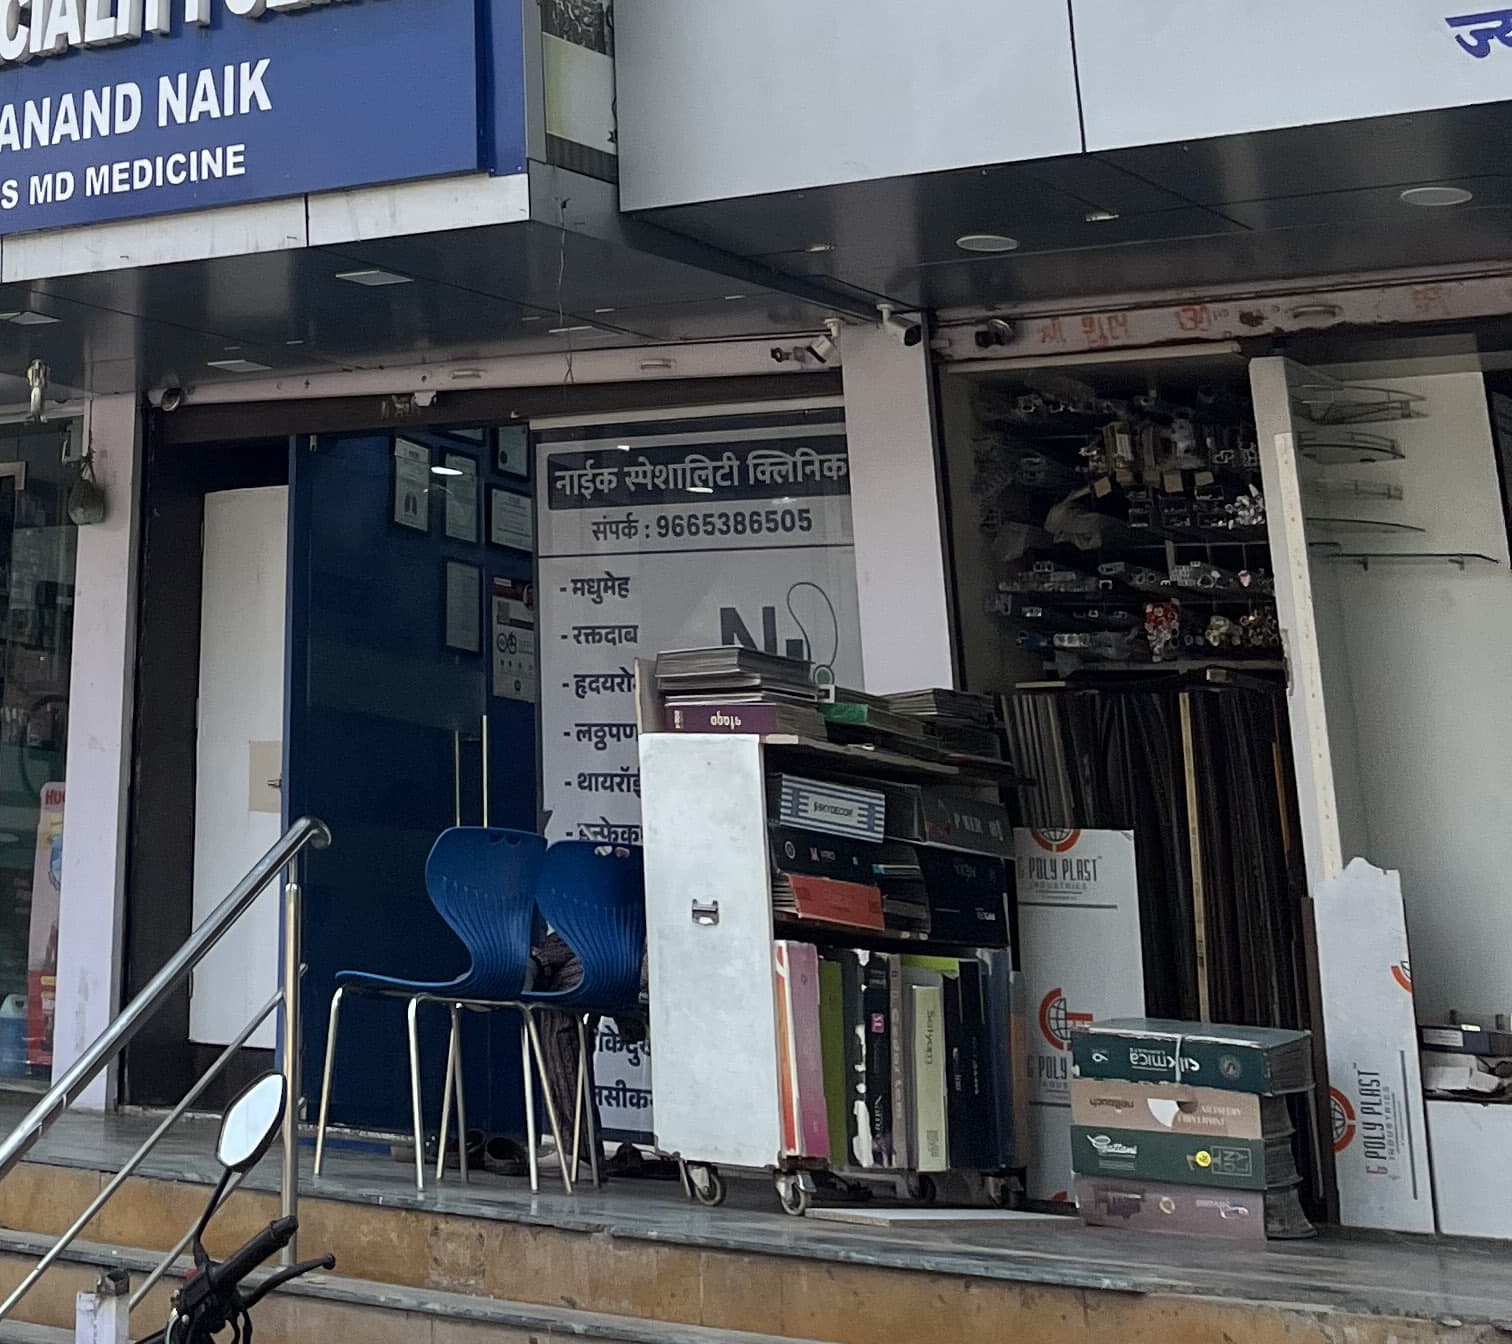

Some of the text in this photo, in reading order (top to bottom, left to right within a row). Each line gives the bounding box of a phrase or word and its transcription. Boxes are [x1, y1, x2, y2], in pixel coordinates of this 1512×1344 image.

[157, 56, 273, 127] NAIK
[29, 169, 75, 204] MD
[85, 143, 247, 198] MEDICINE
[555, 446, 848, 501] नाईक स्पेशालिटी क्लिनिक
[591, 507, 813, 545] संपर्क 9665386505
[571, 569, 631, 603] मधुमेह
[573, 621, 639, 647] रक्तदाब
[1029, 857, 1099, 881] POLY PLAST
[1357, 1069, 1388, 1160] POLY PLAST
